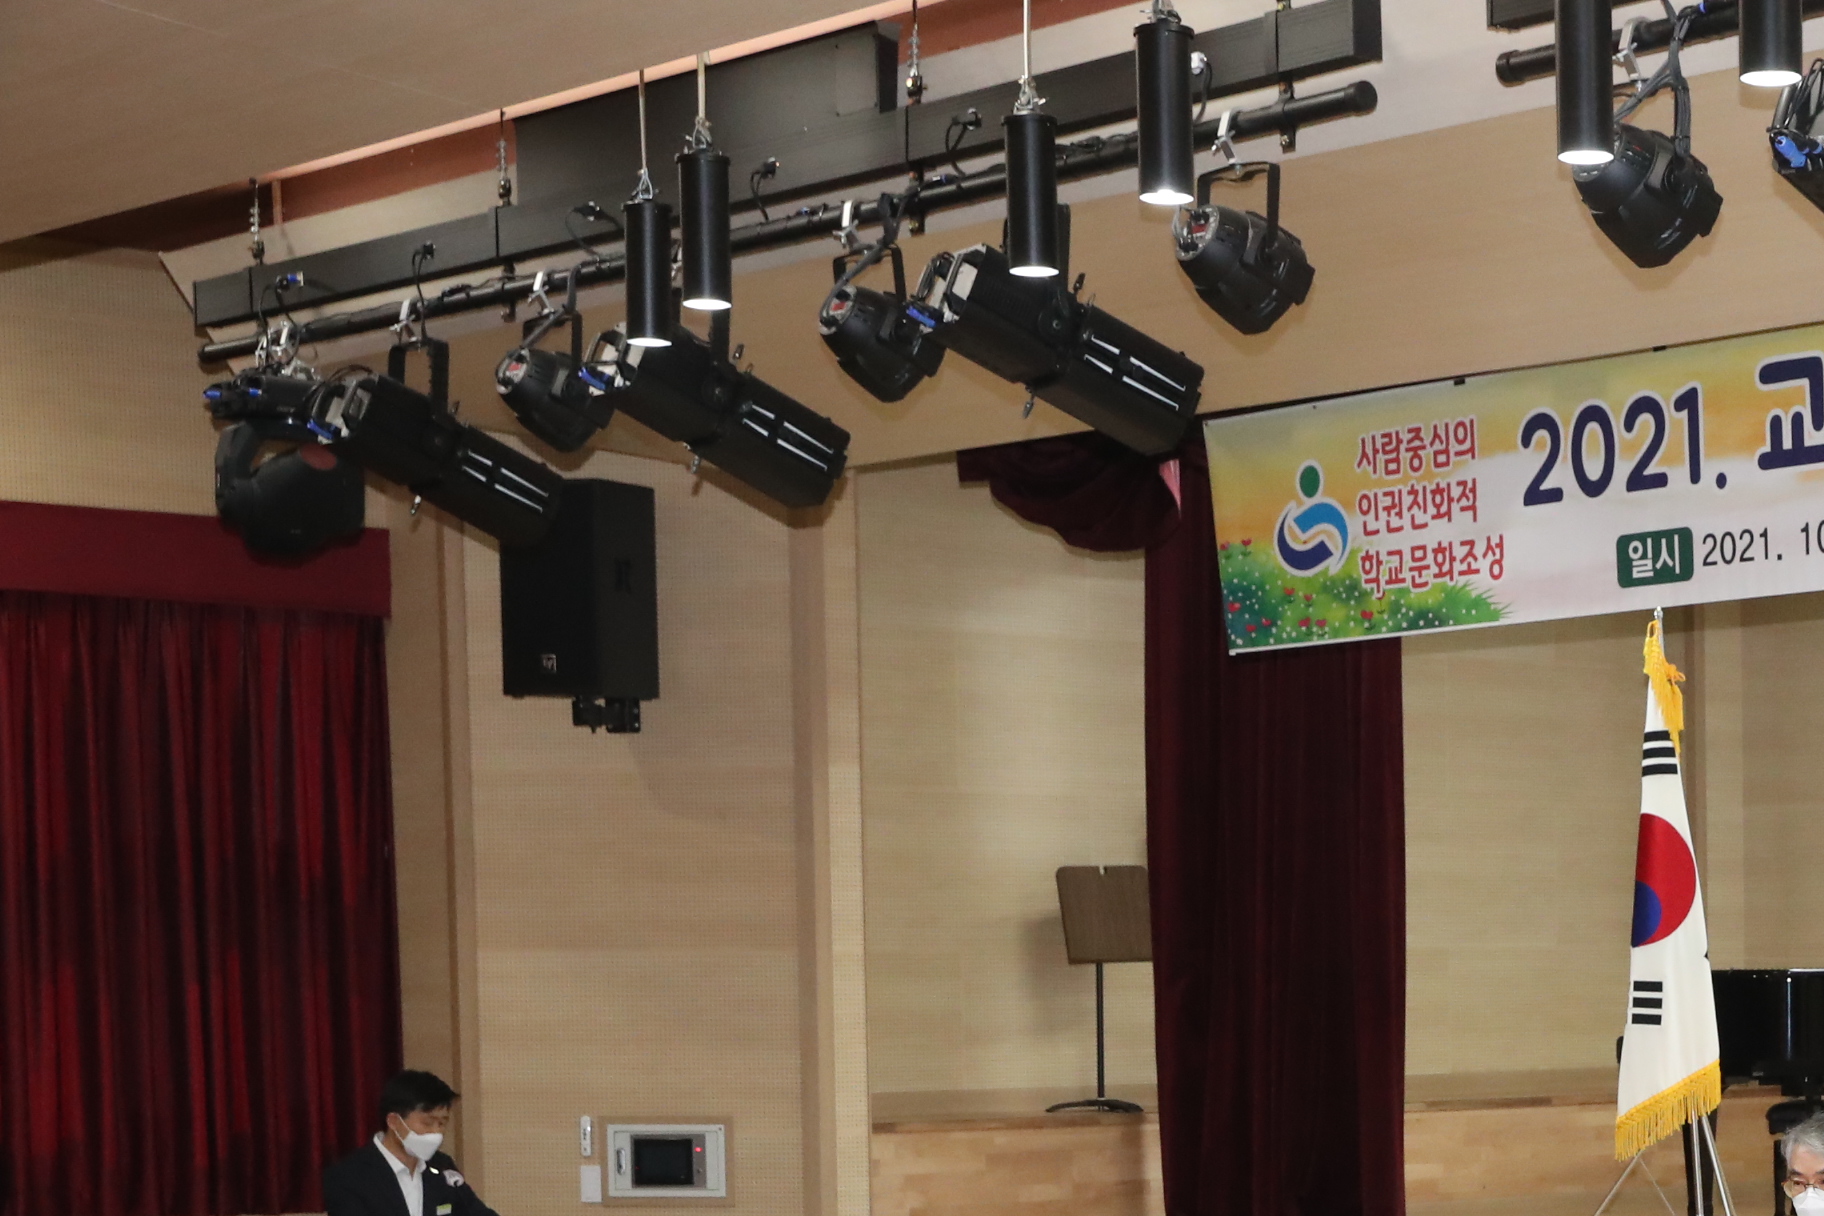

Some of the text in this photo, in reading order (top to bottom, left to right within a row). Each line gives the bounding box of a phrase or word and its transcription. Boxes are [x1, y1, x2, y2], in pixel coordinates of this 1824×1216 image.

[1356, 418, 1477, 476] 사람중심의
[1520, 386, 1727, 507] 2021.
[1357, 477, 1478, 536] 인권친화적
[1360, 533, 1505, 594] 학교문화조성
[1628, 535, 1681, 580] 일시
[1701, 527, 1784, 567] 2021.
